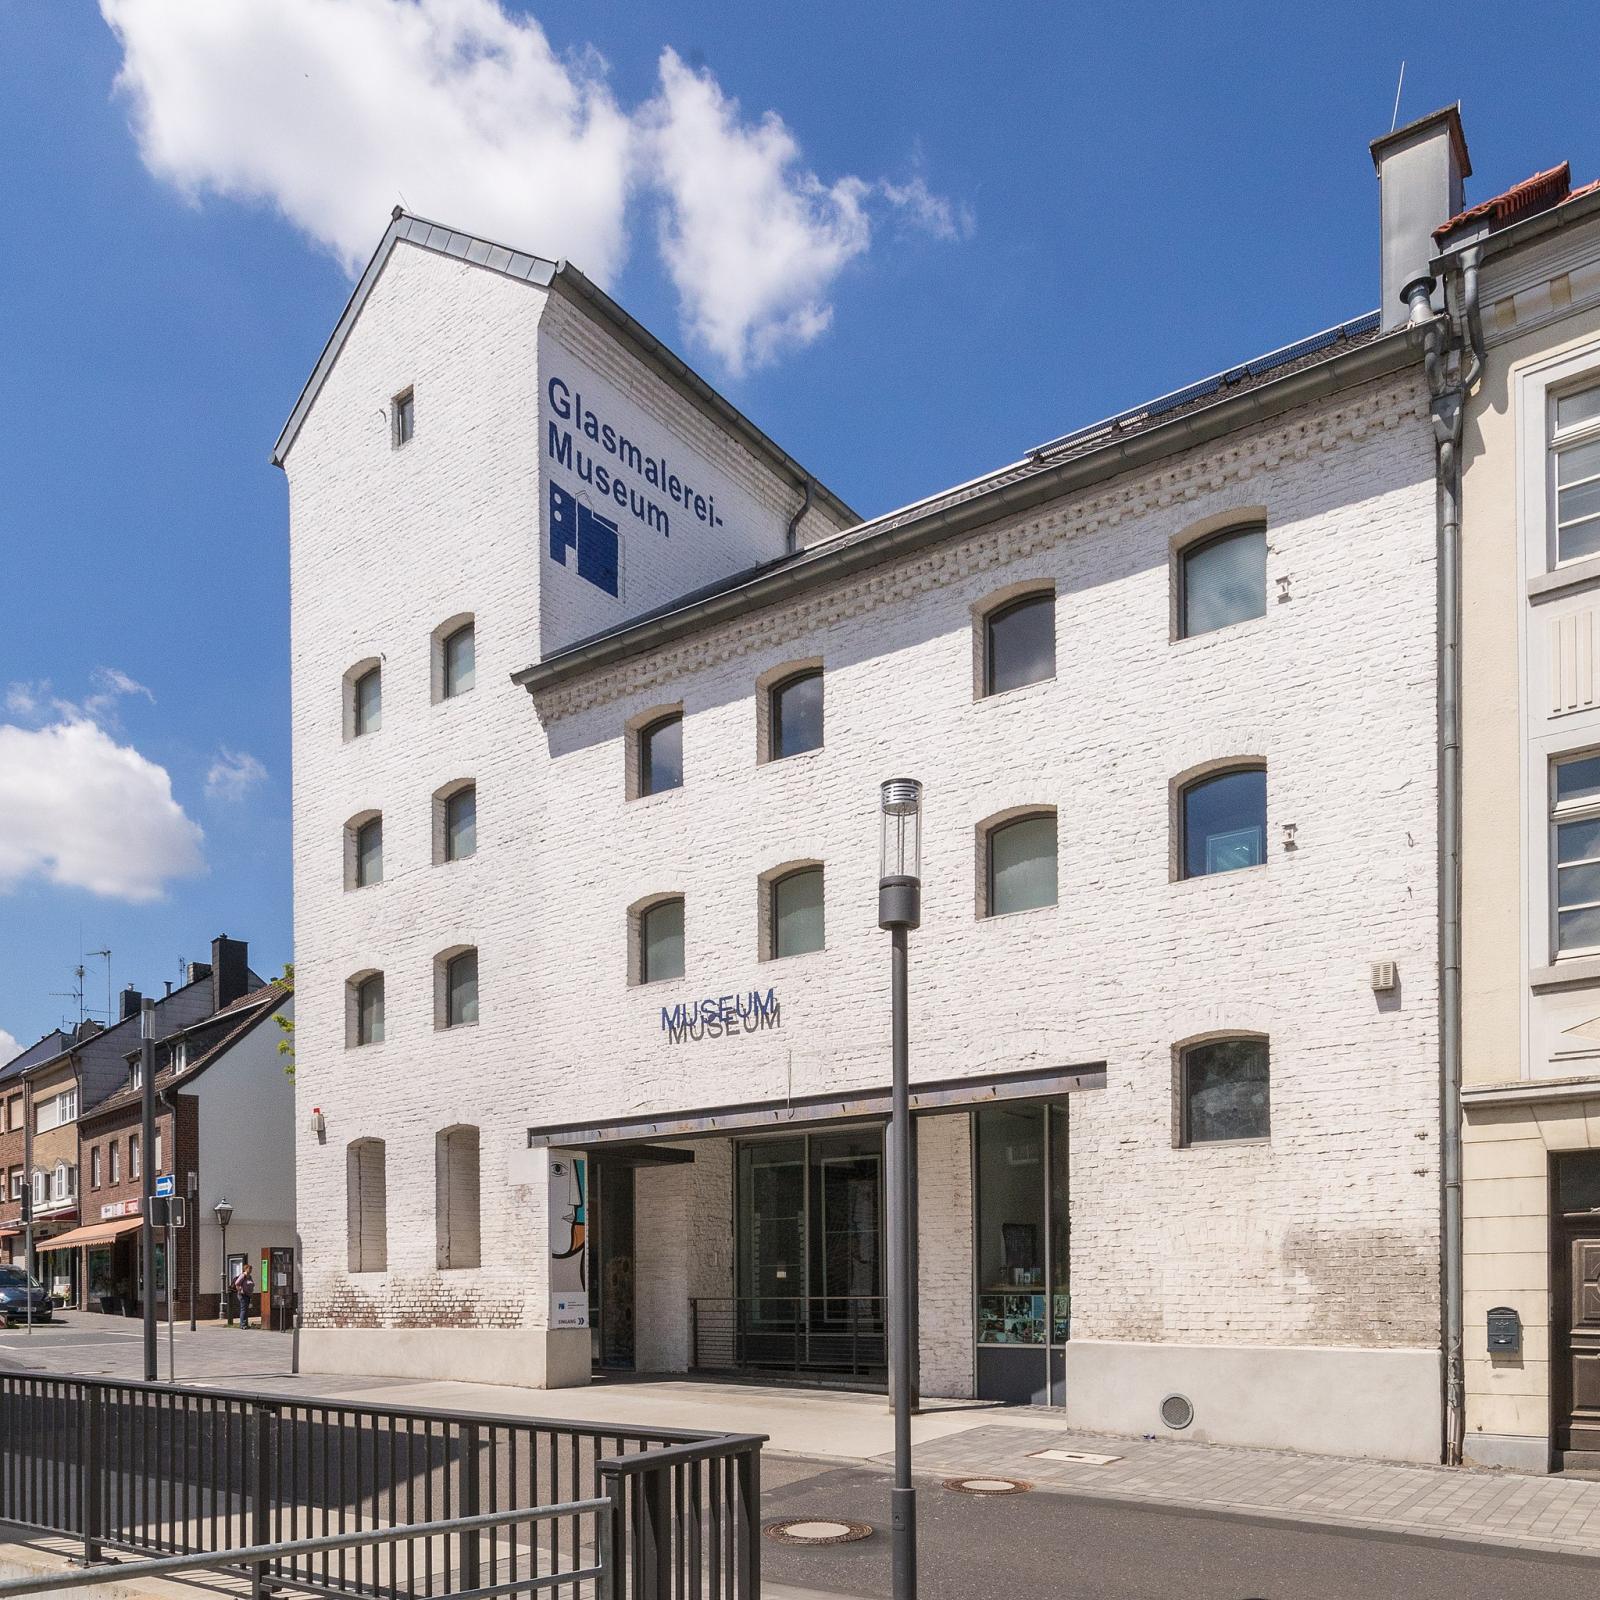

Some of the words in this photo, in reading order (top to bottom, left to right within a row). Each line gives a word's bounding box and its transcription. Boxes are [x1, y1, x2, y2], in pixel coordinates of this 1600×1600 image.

[548, 376, 723, 528] Glasmalerei-
[548, 420, 670, 538] Museum
[661, 987, 775, 1031] MUSEUM
